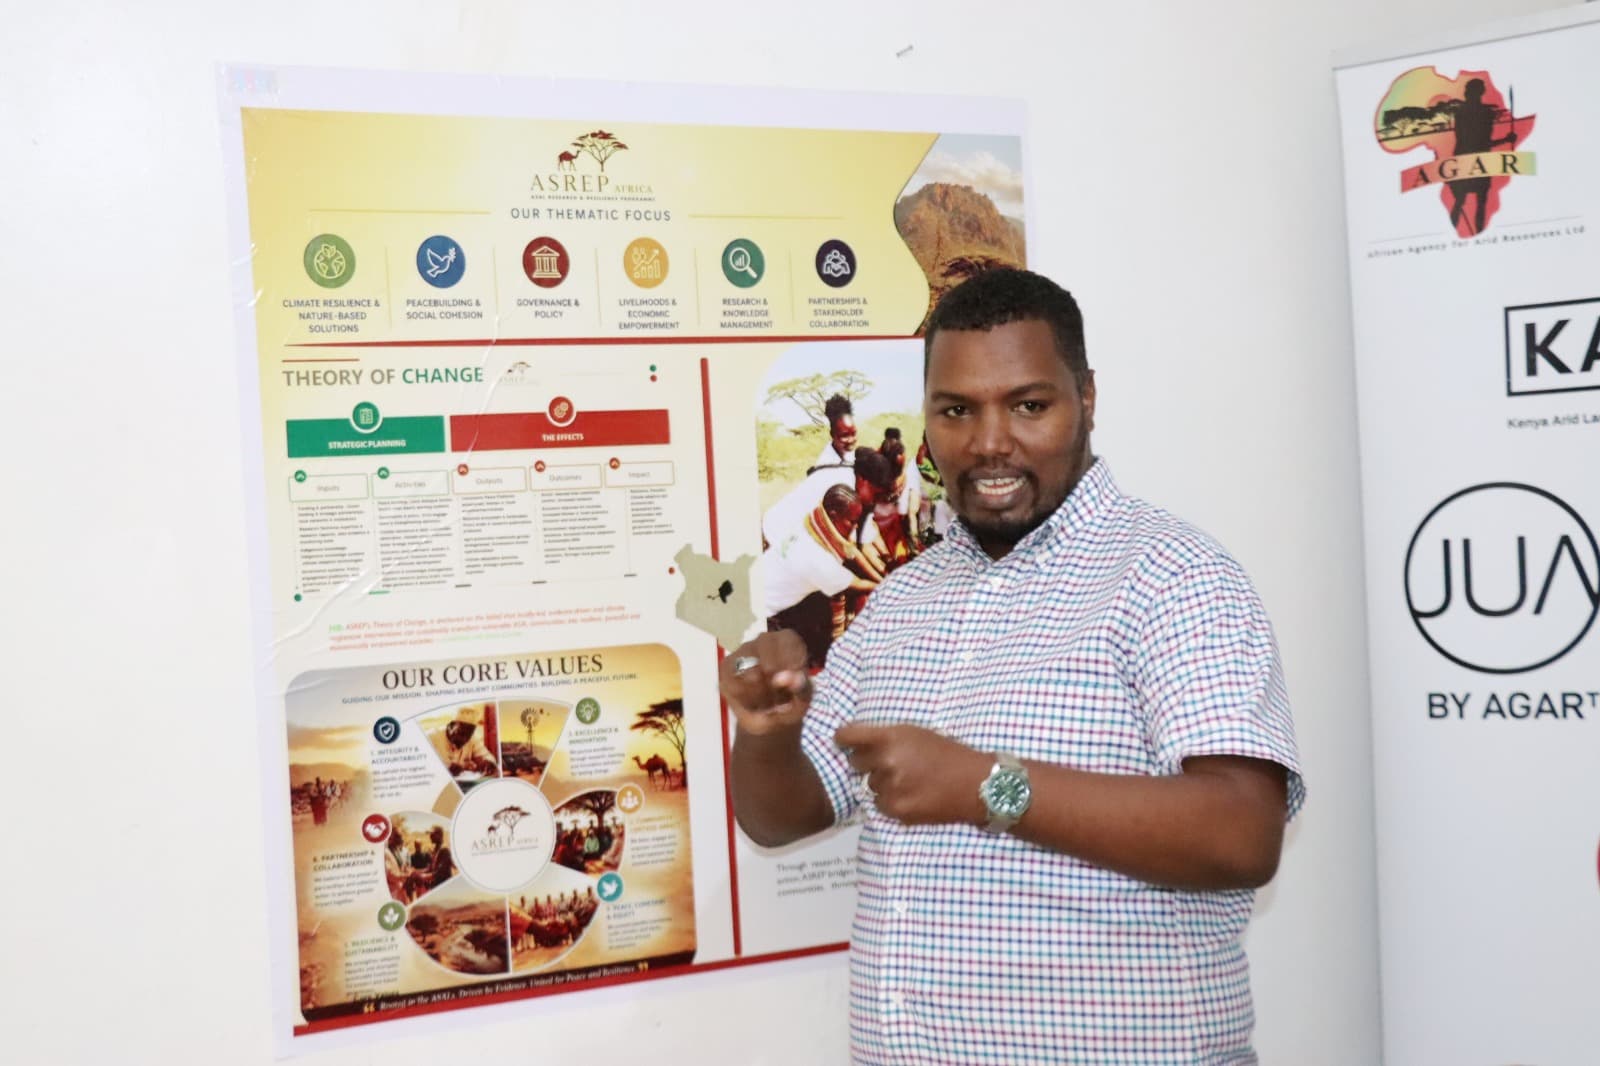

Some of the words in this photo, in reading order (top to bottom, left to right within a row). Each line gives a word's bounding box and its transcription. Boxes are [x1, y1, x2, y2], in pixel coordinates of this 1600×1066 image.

[1413, 154, 1520, 188] AGAR
[530, 174, 610, 192] ASREP
[615, 184, 654, 194] AFRICA
[510, 208, 540, 220] OUR
[547, 208, 620, 220] THEMATIC
[625, 209, 672, 222] FOCUS
[1368, 248, 1404, 258] African
[1408, 243, 1447, 254] Agency
[1475, 236, 1498, 246] Arid
[1502, 230, 1561, 242] Resources
[1566, 226, 1586, 236] Ltd
[282, 299, 320, 308] CLIMATE
[323, 299, 372, 308] RESILIENCE
[374, 299, 380, 308] &
[406, 299, 473, 308] PEACEBUILDING
[475, 299, 481, 308] &
[516, 298, 572, 307] GOVERNANCE
[574, 298, 580, 306] &
[406, 311, 437, 320] SOCIAL
[440, 311, 484, 320] COHESION
[534, 310, 564, 318] POLICY
[722, 310, 769, 318] KNOWLEDGE
[814, 308, 864, 316] STAKEHOLDER
[308, 324, 359, 333] SOLUTIONS
[618, 322, 680, 330] EMPOWERMENT
[720, 320, 773, 328] MANAGEMENT
[809, 320, 870, 328] COLLABORATION
[282, 369, 364, 386] THEORY
[370, 368, 396, 386] OF
[402, 367, 484, 384] CHANGE
[1508, 418, 1548, 430] Kenya
[1552, 414, 1579, 425] Arid
[1582, 413, 1600, 424] La
[542, 434, 555, 442] THE
[556, 434, 584, 442] EFFECTS
[328, 440, 368, 450] STRATEGIC
[369, 440, 406, 448] PLANNING
[549, 474, 582, 482] Outcomes
[628, 471, 650, 479] Impact
[475, 477, 503, 486] Outputs
[317, 484, 340, 493] Inputs
[382, 668, 435, 690] OUR
[443, 661, 508, 684] CORE
[516, 654, 604, 678] VALUES
[342, 696, 373, 704] GUIDING
[426, 689, 456, 697] SHAPING
[541, 678, 572, 688] BUILDING
[580, 675, 610, 684] PEACEFUL
[1428, 692, 1471, 720] BY
[380, 1000, 406, 1010] Rooted
[566, 972, 586, 982] Peace
[588, 971, 602, 979] and
[603, 966, 635, 978] Resilience
